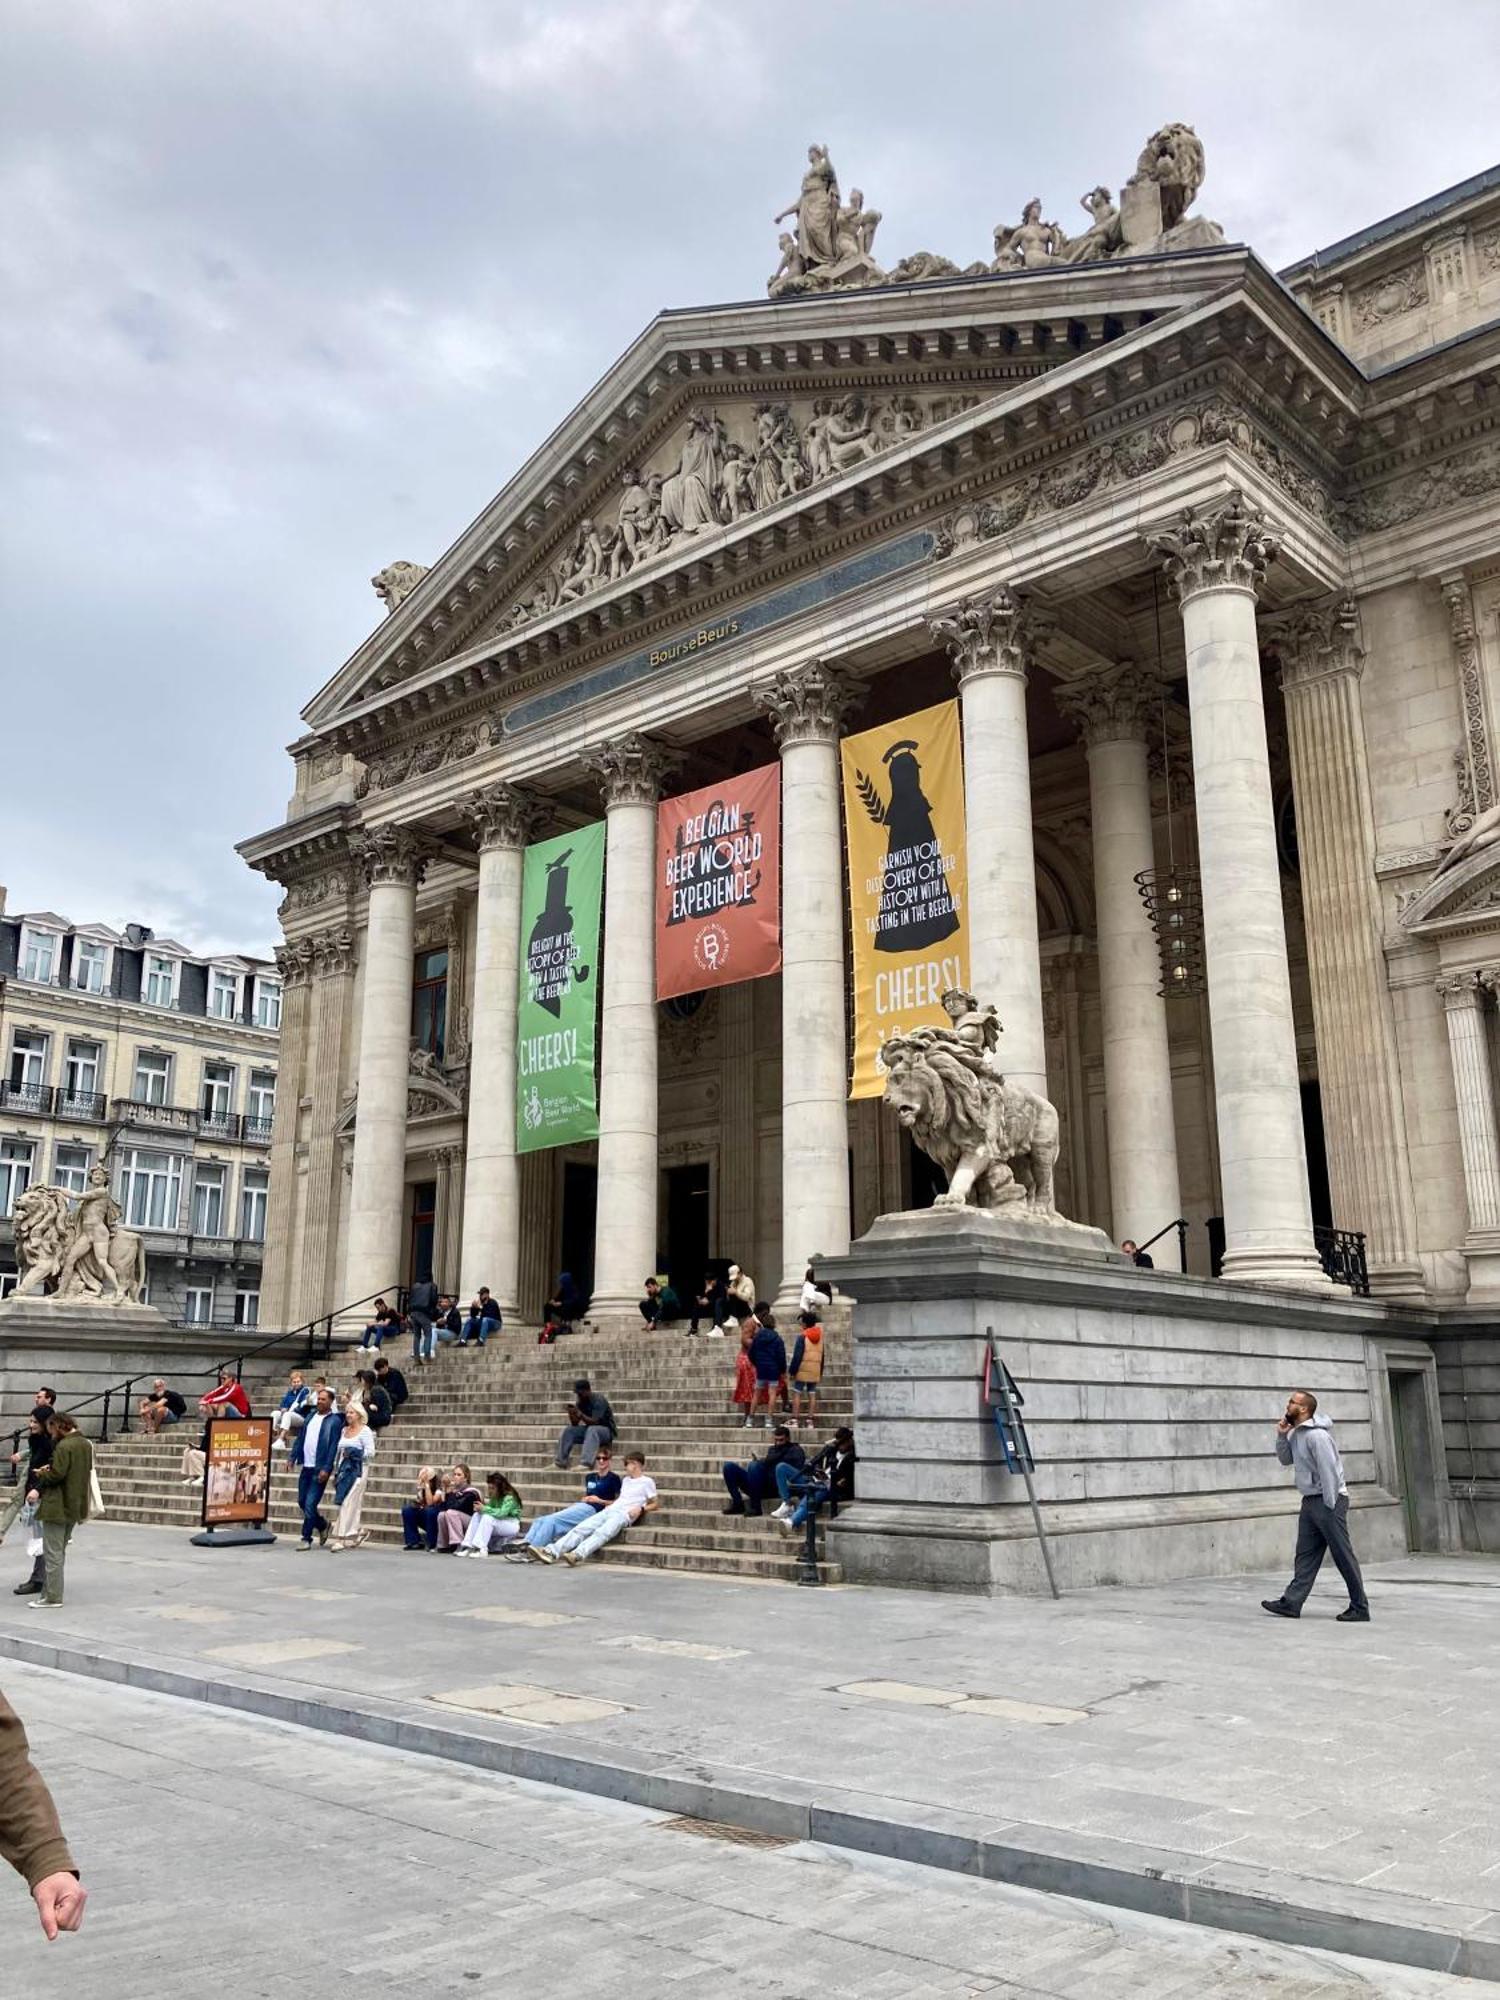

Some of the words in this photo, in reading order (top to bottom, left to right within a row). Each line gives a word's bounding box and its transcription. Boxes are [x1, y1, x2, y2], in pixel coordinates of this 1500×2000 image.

[666, 851, 696, 886] BEER
[700, 833, 762, 875] WORLD
[918, 861, 935, 880] OF
[937, 854, 956, 876] BEER
[942, 878, 948, 895] A
[911, 903, 927, 923] THE
[551, 948, 565, 965] OF
[520, 1027, 577, 1077] CHEERS!
